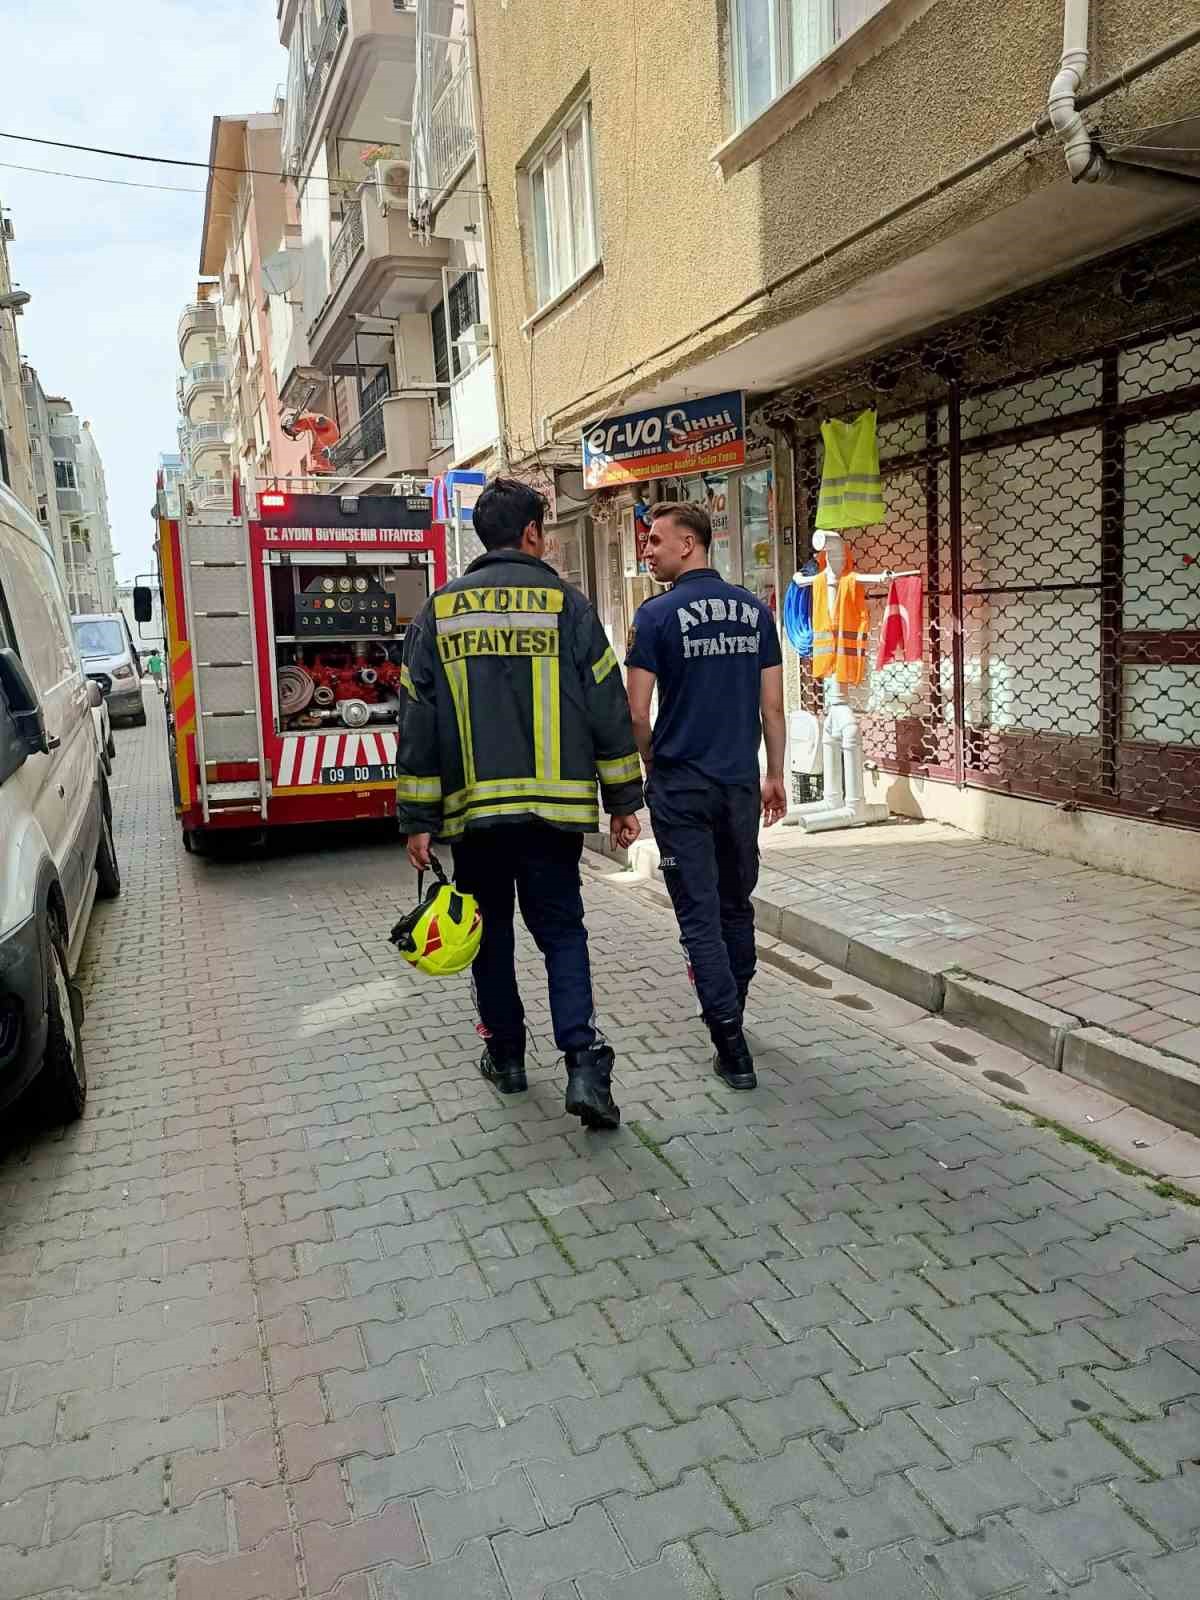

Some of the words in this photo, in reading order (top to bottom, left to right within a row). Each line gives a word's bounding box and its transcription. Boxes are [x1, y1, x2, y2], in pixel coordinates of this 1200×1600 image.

[588, 417, 662, 454] er-va
[264, 528, 281, 541] T.C.
[281, 528, 313, 541] AYDIN
[316, 528, 377, 543] BÜYÜKŞEHİR
[453, 590, 547, 613] AYDIN
[677, 599, 760, 633] AYDIN
[441, 629, 556, 660] İTFAİYESİ
[329, 769, 344, 782] 09
